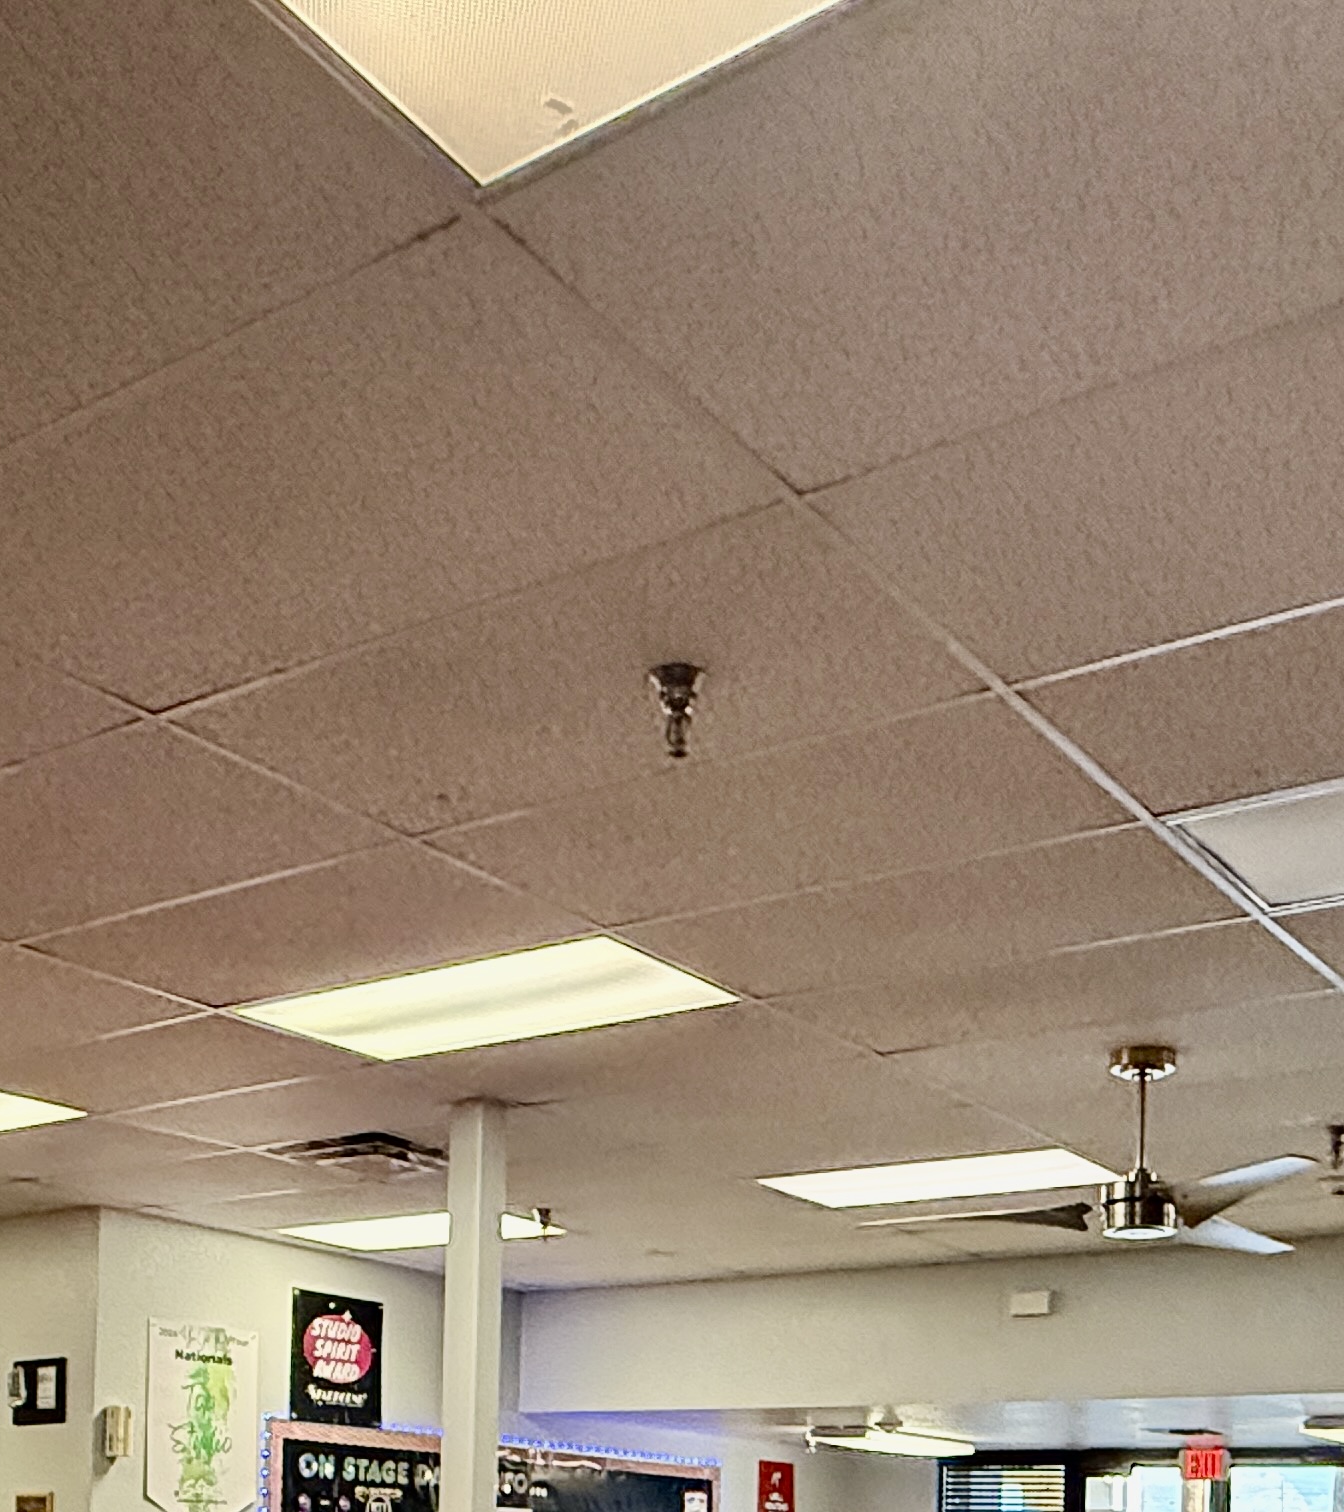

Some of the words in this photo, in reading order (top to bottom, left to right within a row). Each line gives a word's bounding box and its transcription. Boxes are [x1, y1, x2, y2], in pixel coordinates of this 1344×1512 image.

[310, 1317, 362, 1344] STUDIO
[175, 1349, 233, 1366] Nationals
[313, 1338, 361, 1362] SPIRIT
[312, 1359, 362, 1383] AWARD
[299, 1453, 336, 1480] ON
[342, 1457, 410, 1485] STAGE
[1185, 1450, 1223, 1479] EXIT
